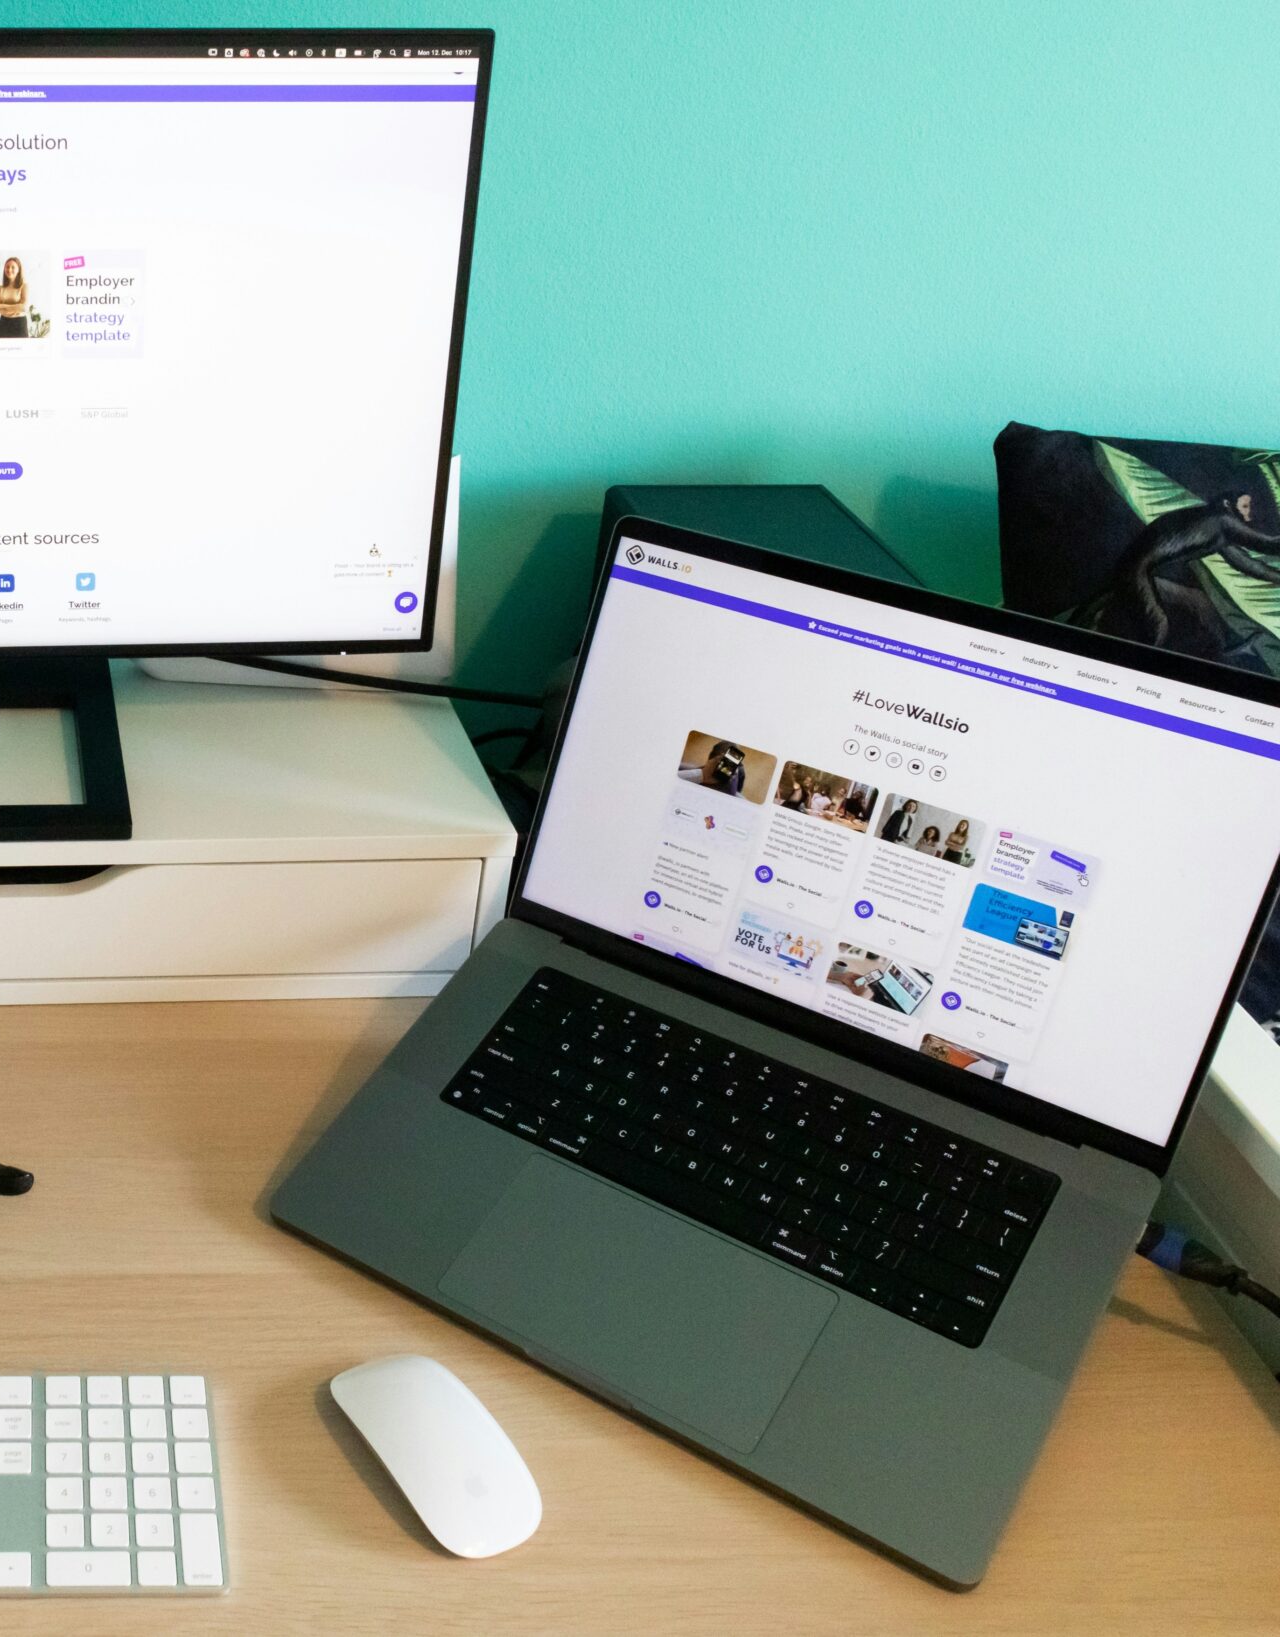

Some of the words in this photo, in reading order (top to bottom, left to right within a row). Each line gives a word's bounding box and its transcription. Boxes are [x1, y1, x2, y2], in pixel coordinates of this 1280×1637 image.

[66, 275, 135, 290] Employer
[66, 293, 120, 304] brandin
[66, 312, 125, 326] strategy
[66, 330, 131, 344] template
[5, 409, 39, 419] LUSH
[100, 410, 128, 418] Global
[33, 533, 99, 545] sources
[648, 556, 692, 573] WALLS.IO
[68, 600, 101, 609] Twitter
[818, 624, 838, 635] Exceed
[854, 635, 884, 648] marketing
[885, 644, 901, 652] goals
[902, 647, 916, 656] with
[922, 653, 940, 663] social
[942, 658, 957, 667] wall!
[958, 662, 976, 672] Learn
[976, 667, 991, 676] how
[991, 671, 999, 679] in
[1011, 677, 1025, 686] free
[1025, 682, 1057, 696] webinars.
[969, 642, 998, 654] Features
[1023, 656, 1051, 669] Industry
[1077, 670, 1110, 684] Solutions
[1136, 686, 1162, 699] Pricing
[1180, 698, 1216, 713] Resources
[1245, 715, 1275, 728] Contact
[852, 689, 969, 734] #LoveWallsio
[854, 725, 868, 735] The
[871, 729, 901, 744] Walls.io
[902, 740, 926, 752] social
[928, 747, 948, 760] story
[999, 840, 1036, 856] Employer
[996, 848, 1030, 864] branding
[994, 857, 1024, 871] strategy
[991, 865, 1025, 881] template
[986, 907, 1018, 921] League
[737, 928, 765, 944] VOTE
[735, 934, 755, 948] FOR
[758, 944, 772, 955] US
[593, 1056, 604, 1064] W
[627, 1071, 635, 1079] E
[483, 1106, 505, 1120] control
[731, 1116, 739, 1124] Y
[517, 1122, 537, 1135] option
[549, 1137, 579, 1154] command
[1003, 1208, 1028, 1223] delete
[772, 1240, 806, 1260] command
[821, 1264, 844, 1278] option
[976, 1264, 1000, 1279] return
[966, 1296, 985, 1308] shift
